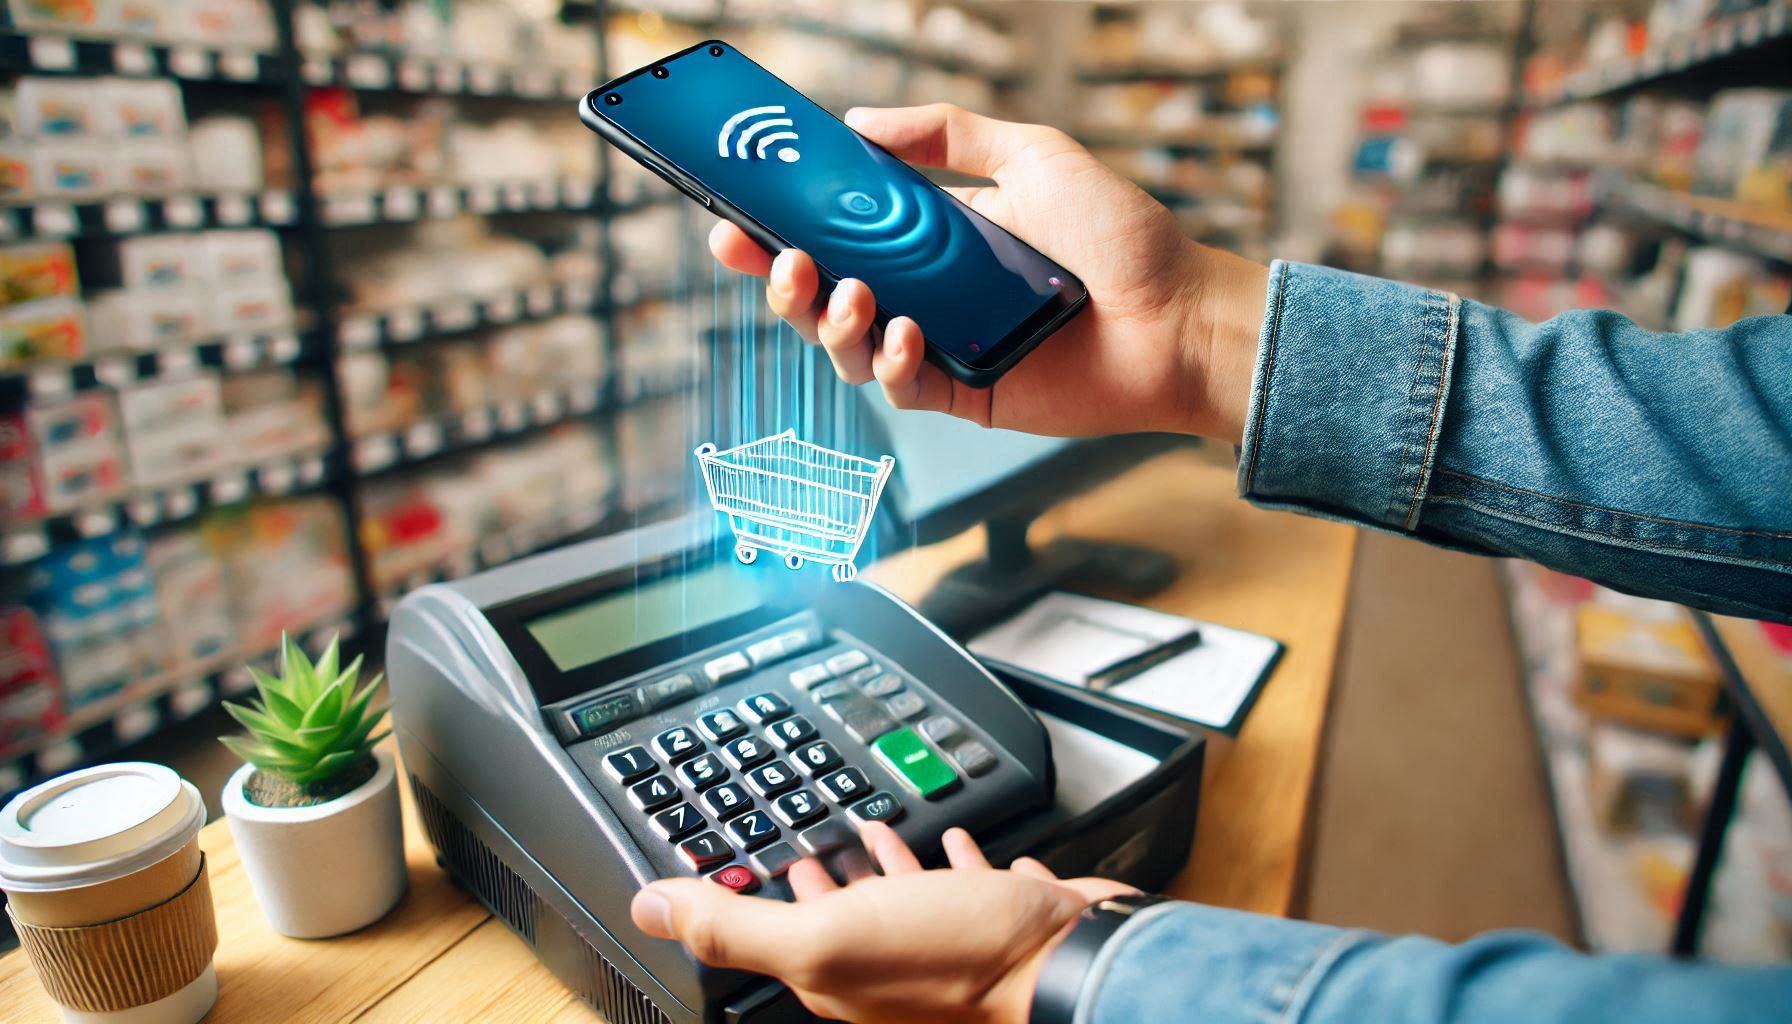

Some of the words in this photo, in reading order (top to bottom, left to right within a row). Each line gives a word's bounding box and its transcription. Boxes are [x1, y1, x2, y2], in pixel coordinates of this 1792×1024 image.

[667, 729, 692, 751] 2
[623, 753, 637, 770] 1
[670, 806, 685, 829] 7
[743, 815, 766, 837] 2
